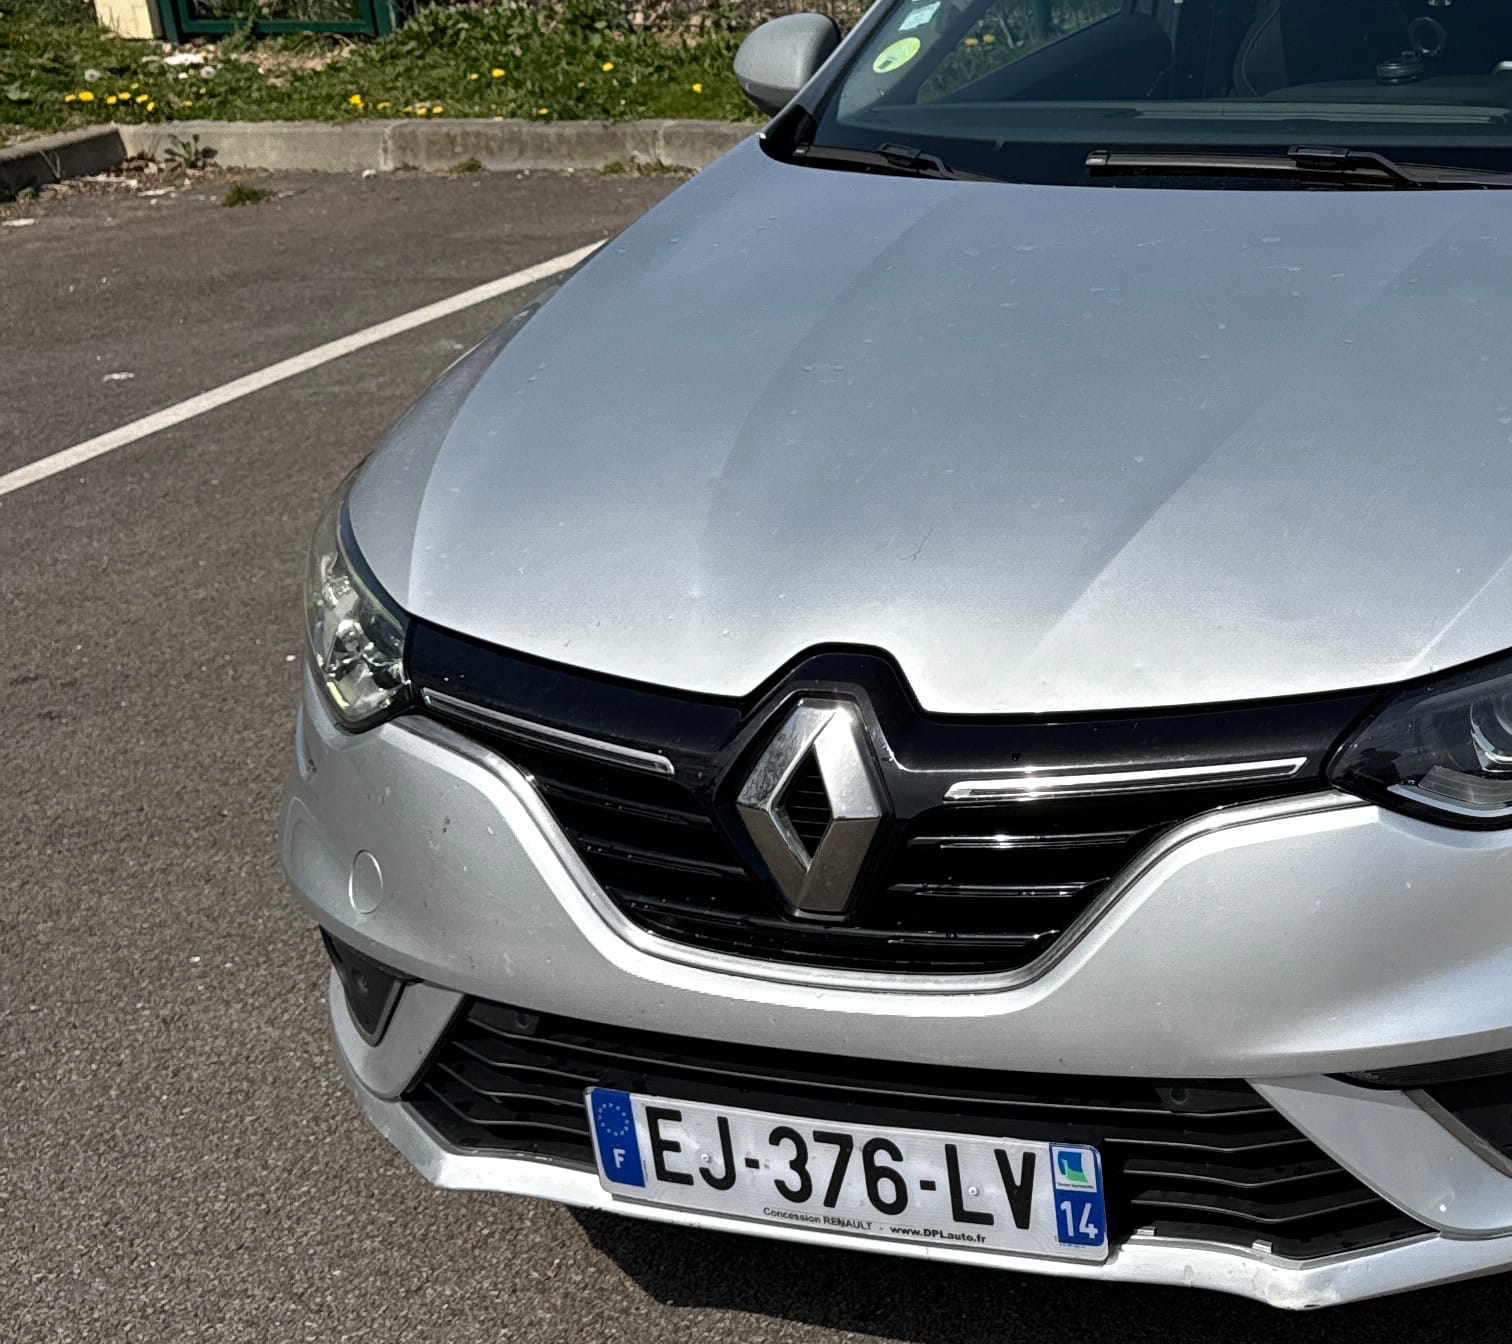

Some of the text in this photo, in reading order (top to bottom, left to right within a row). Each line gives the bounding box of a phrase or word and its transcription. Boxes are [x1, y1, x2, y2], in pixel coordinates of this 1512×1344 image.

[613, 1148, 625, 1168] F
[645, 1106, 1036, 1230] EJ-376-LV
[763, 1207, 821, 1224] Concession
[823, 1216, 872, 1231] RENAULT
[890, 1225, 986, 1243] www.DPLauto.fr
[1060, 1200, 1098, 1239] 14
